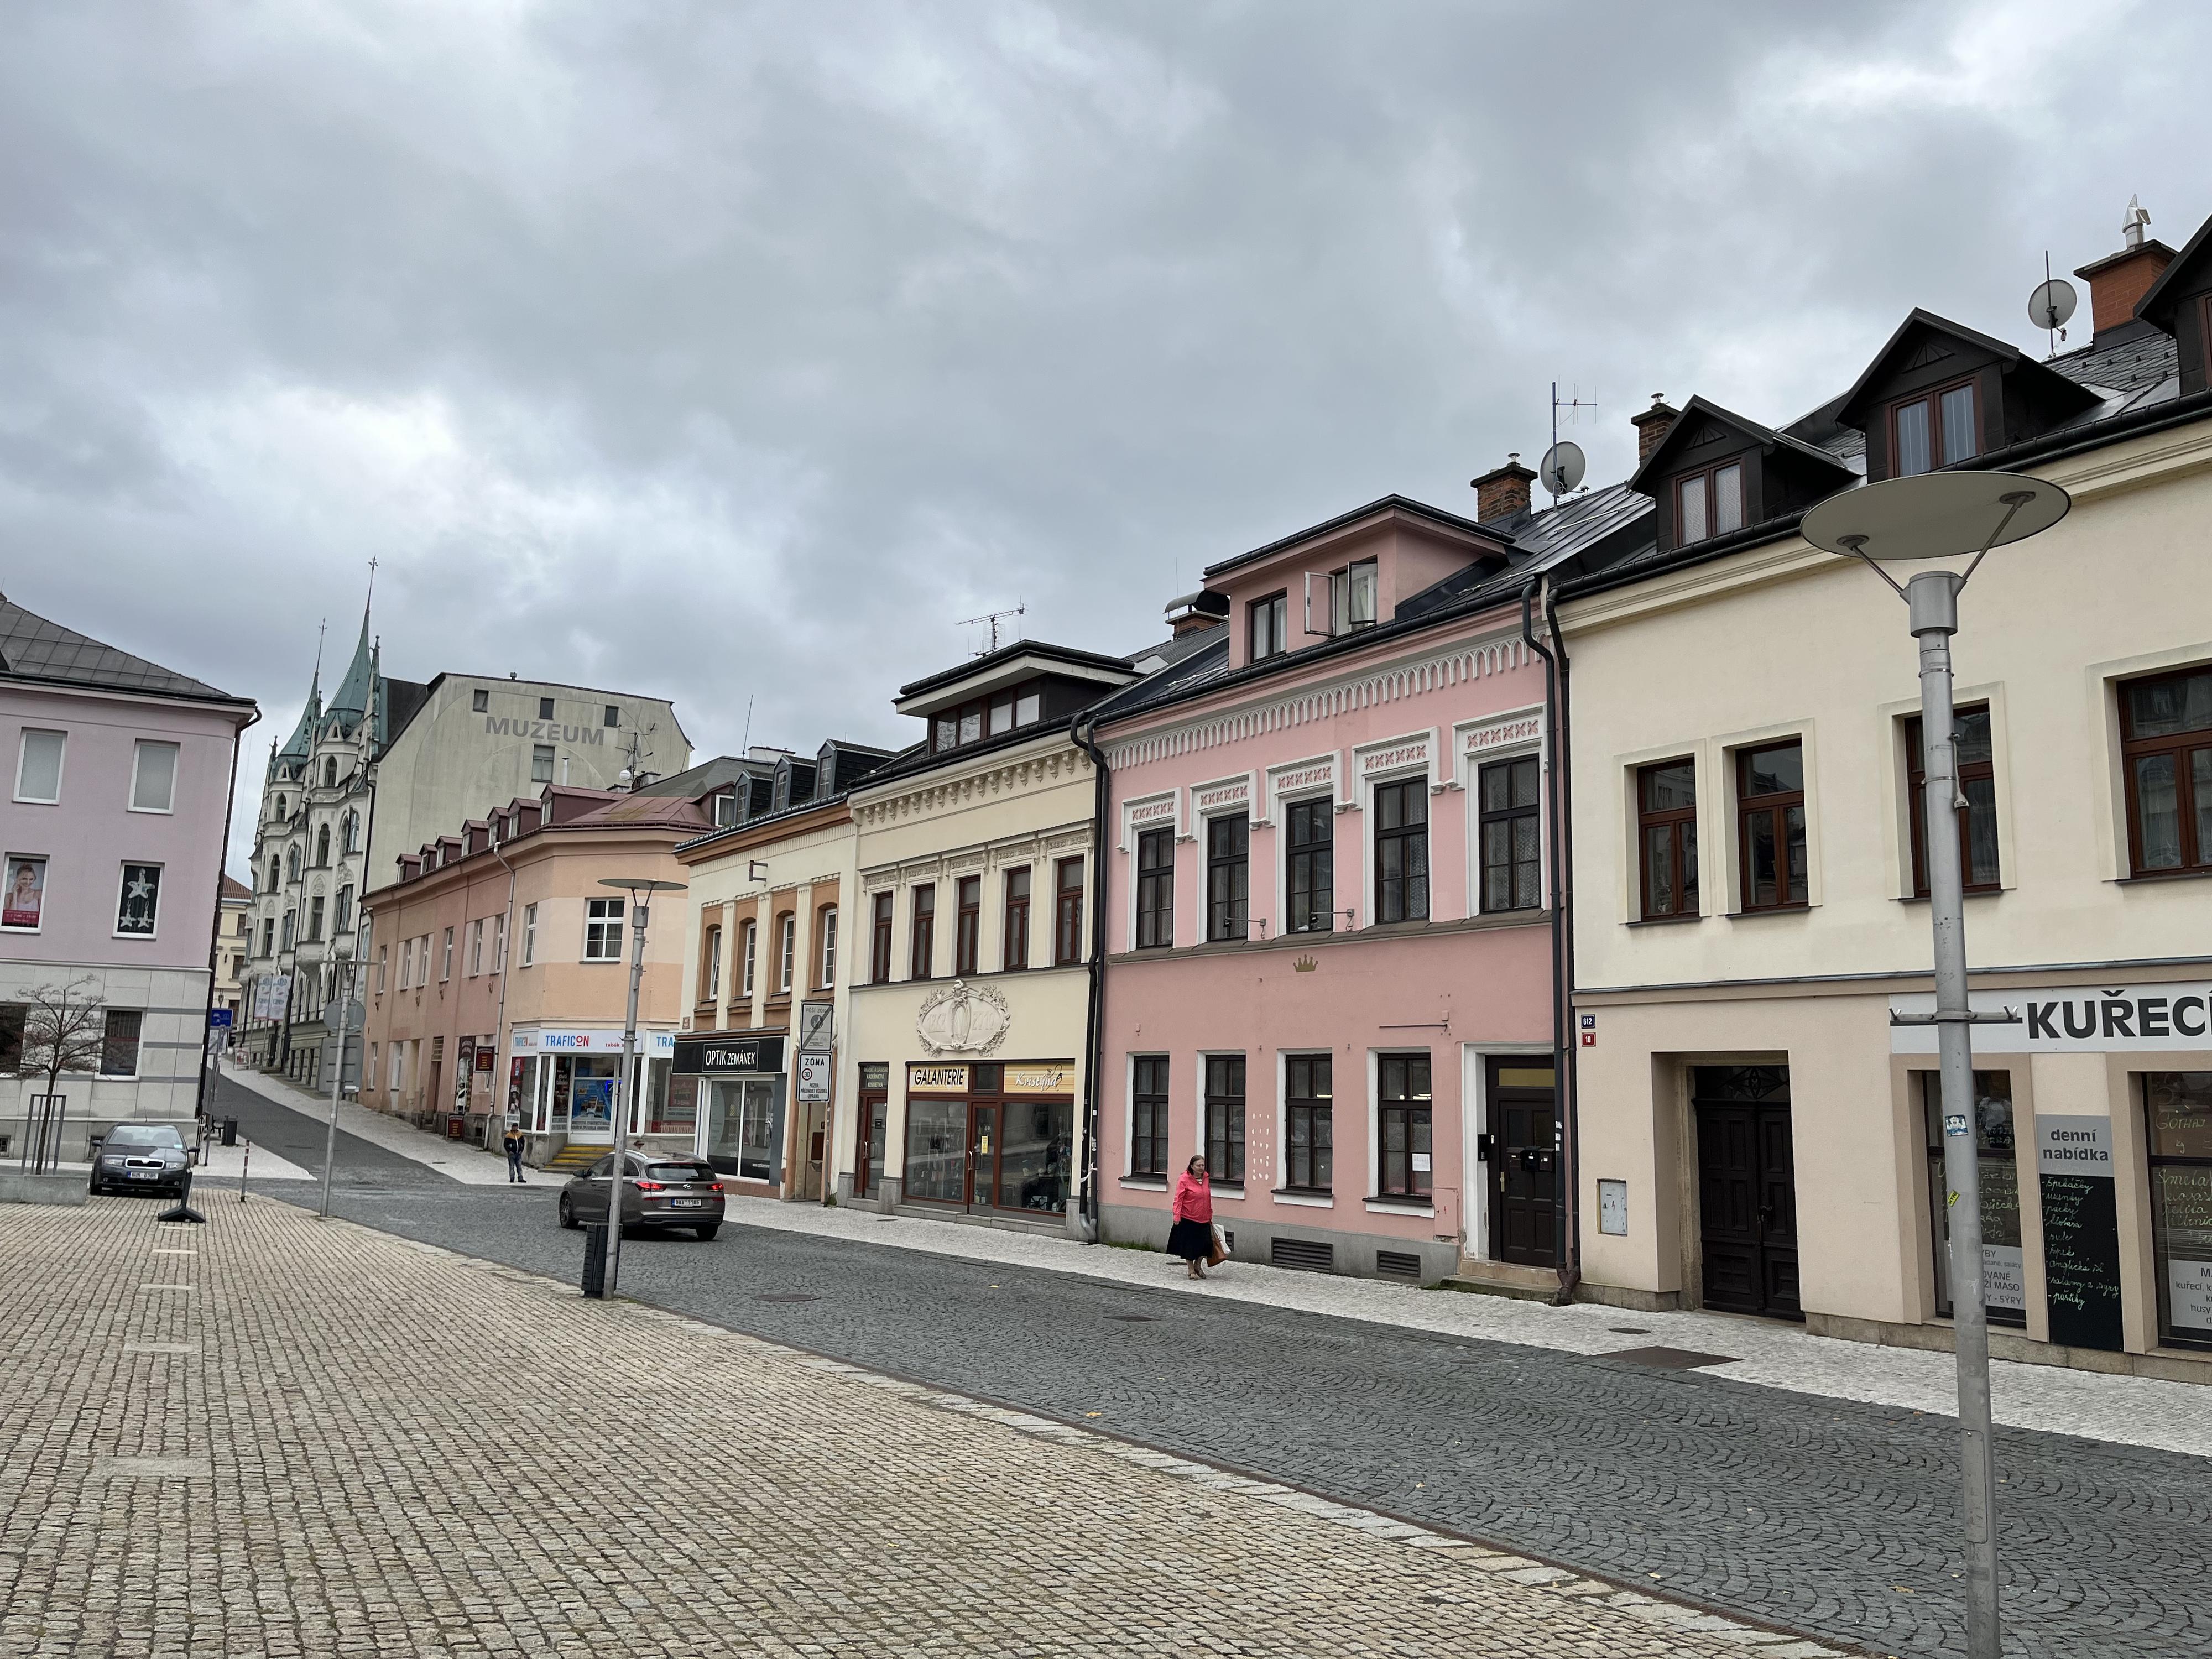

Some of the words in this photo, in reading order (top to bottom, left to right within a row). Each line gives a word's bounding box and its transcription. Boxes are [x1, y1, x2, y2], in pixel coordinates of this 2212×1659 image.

[486, 716, 604, 746] MUZEUM
[545, 1035, 589, 1047] TRAFICON
[706, 1050, 727, 1066] OPTIK
[727, 1049, 755, 1065] ZEMÁNEK
[805, 1057, 825, 1066] ZÓNA
[914, 1068, 964, 1086] GALANTERIE
[1014, 1072, 1058, 1092] Kristýna
[2050, 1129, 2097, 1142] denní
[2043, 1146, 2109, 1161] nabídka
[2200, 1267, 2212, 1277] M
[1994, 1281, 2020, 1291] MASO
[2176, 1281, 2204, 1292] kuřecí,
[1999, 1294, 2022, 1305] SÝRY
[2190, 1303, 2211, 1314] husy
